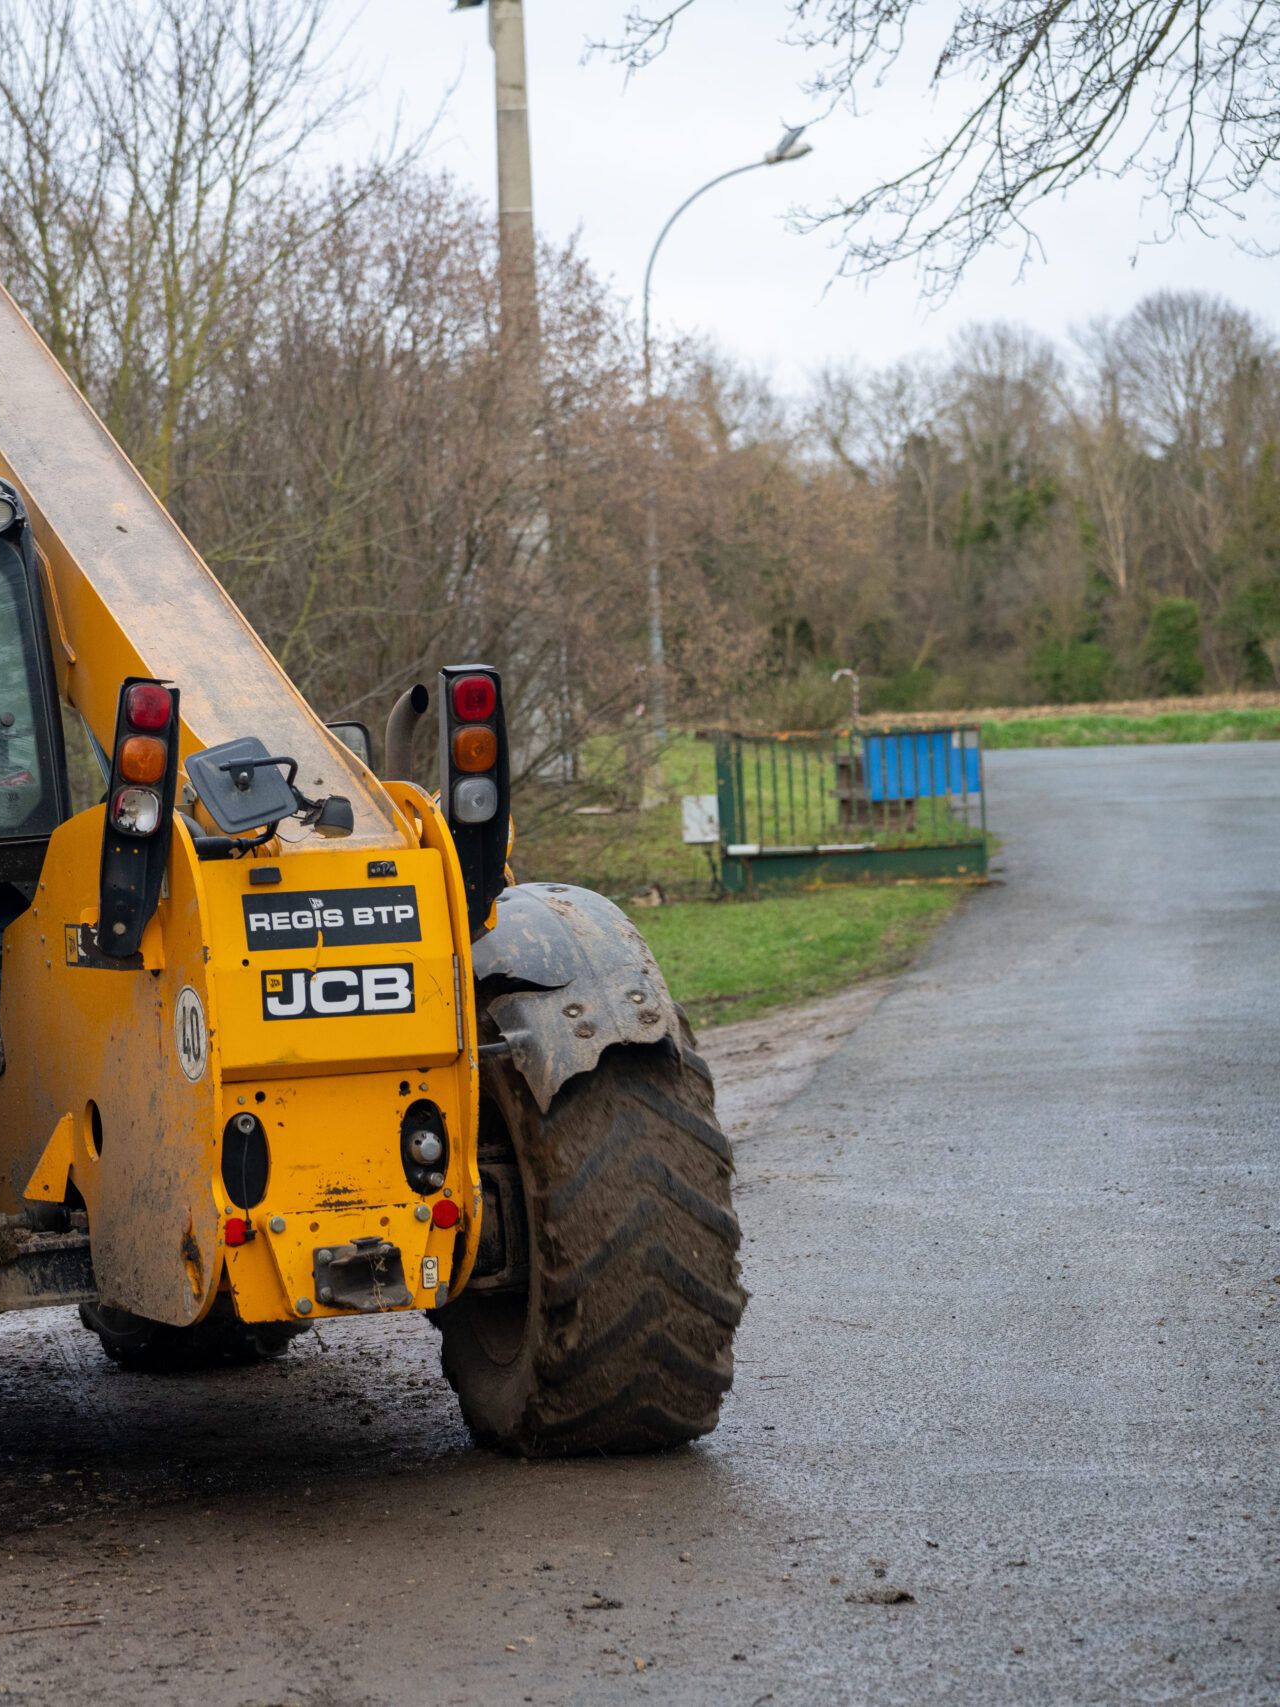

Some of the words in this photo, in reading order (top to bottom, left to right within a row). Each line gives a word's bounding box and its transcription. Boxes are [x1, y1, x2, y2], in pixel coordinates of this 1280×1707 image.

[248, 909, 345, 932] REGIS
[352, 905, 415, 926] BTP
[266, 967, 412, 1017] JCB
[182, 1006, 201, 1062] 40
